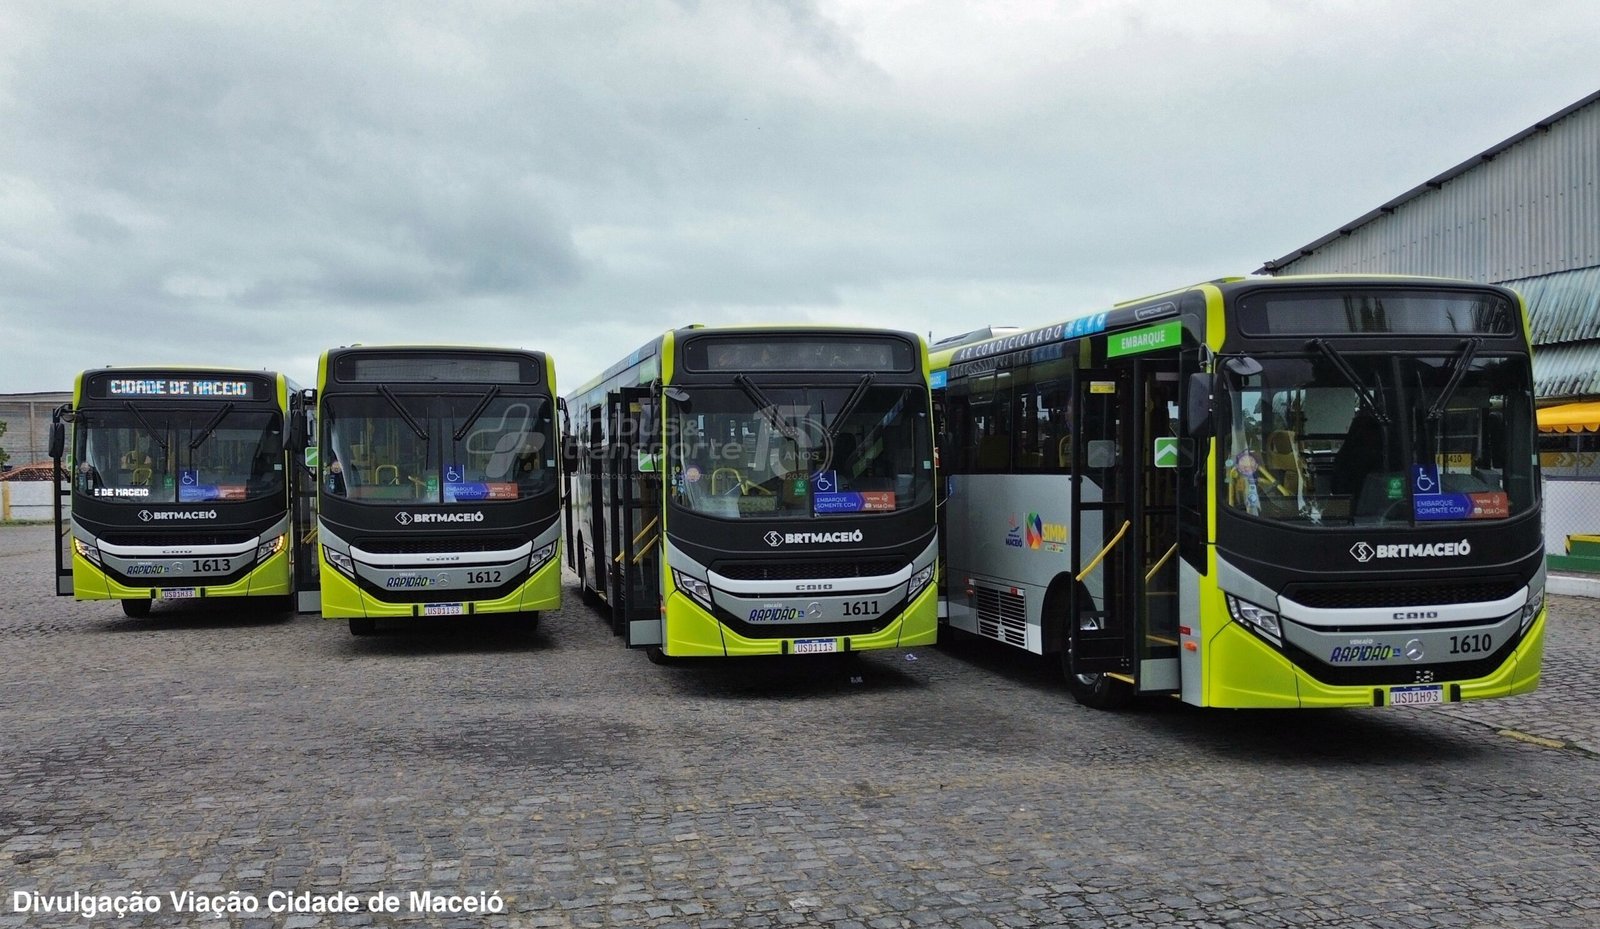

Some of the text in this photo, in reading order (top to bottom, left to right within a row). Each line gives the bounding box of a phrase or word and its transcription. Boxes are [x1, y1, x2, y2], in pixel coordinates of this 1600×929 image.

[960, 325, 1062, 360] AR CONDICIONADO
[1121, 330, 1166, 349] EMBARQUE
[110, 380, 166, 394] CIDADE
[170, 380, 190, 394] DE
[101, 488, 114, 496] DE
[153, 509, 217, 520] BRTMACEIÓ
[413, 511, 484, 523] BRTMACEIÓ
[1416, 506, 1465, 515] SOMENTE COM
[785, 529, 863, 544] BRTMACEIÓ
[1376, 538, 1471, 559] BRTMACEIÓ
[193, 559, 231, 573] 1613
[467, 571, 501, 584] 1612
[748, 606, 797, 621] RAPIDÃO
[843, 601, 880, 616] 1611
[1449, 633, 1492, 654] 1610
[1329, 643, 1391, 663] RAPIDÃO
[1394, 690, 1438, 704] USD1H93
